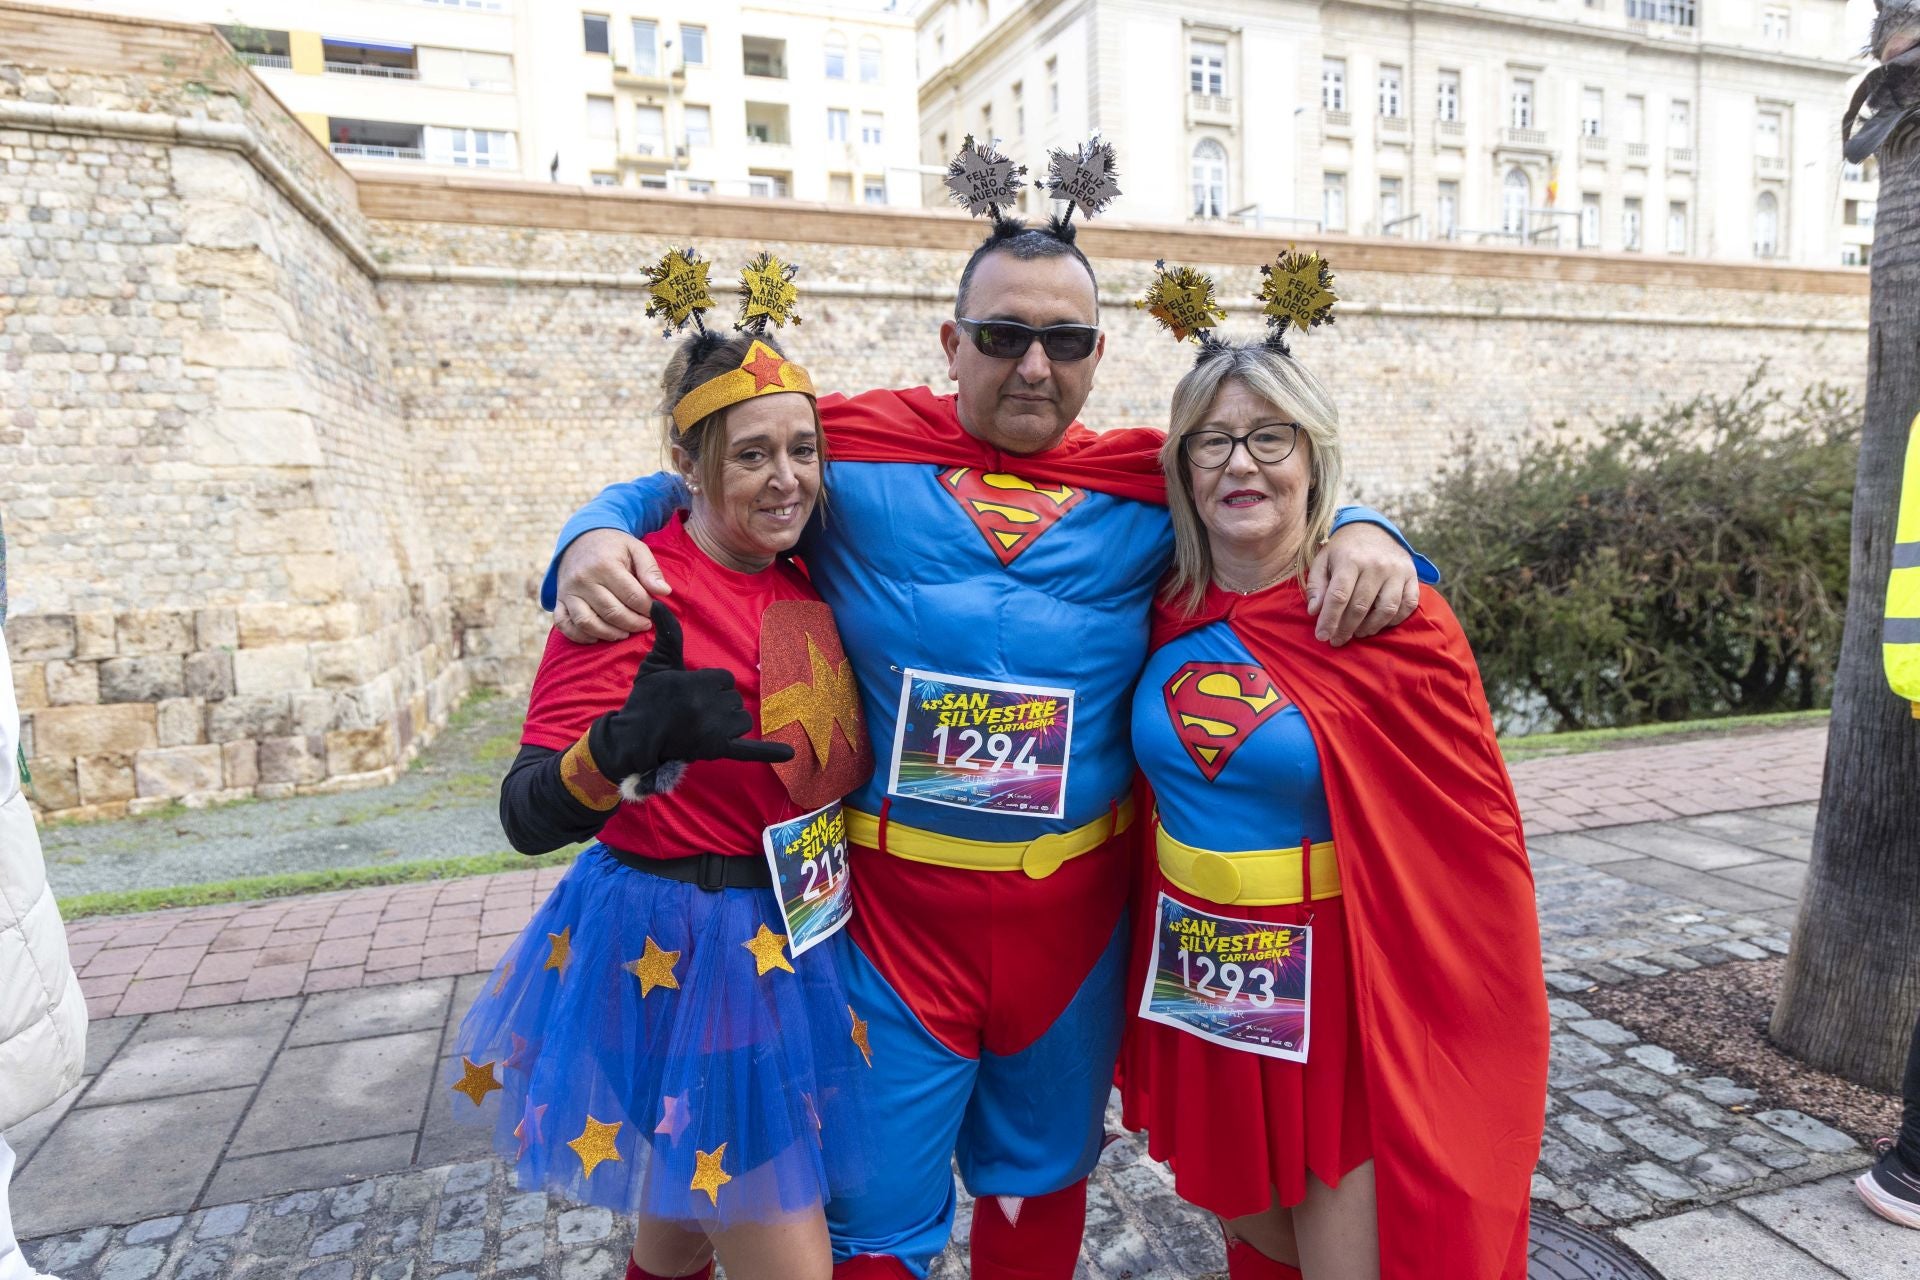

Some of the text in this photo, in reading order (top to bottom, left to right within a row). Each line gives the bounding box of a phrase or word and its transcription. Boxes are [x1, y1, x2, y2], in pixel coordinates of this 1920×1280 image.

[966, 167, 996, 183] FELIZ
[973, 177, 997, 192] AÑO
[1075, 167, 1105, 190] FELIZ
[969, 186, 1007, 204] NUEVO
[1061, 181, 1095, 207] NUEVO
[1072, 177, 1095, 196] AÑO
[668, 270, 697, 289] FELIZ
[759, 276, 785, 292] FELIZ
[1288, 278, 1320, 300] FELIZ
[675, 282, 698, 298] AÑO
[760, 287, 781, 301] AÑO
[1284, 290, 1310, 307] AÑO
[672, 291, 706, 311] NUEVO
[753, 296, 784, 314] NUEVO
[1163, 293, 1194, 313] FELIZ
[1273, 296, 1311, 320] NUEVO
[1171, 311, 1206, 330] NUEVO
[940, 692, 991, 710] SAN
[936, 700, 1058, 728] SILVESTRE
[988, 718, 1055, 734] CARTAGENA
[932, 726, 1039, 776] 1294
[801, 812, 828, 847] SAN
[800, 836, 849, 902] 213
[1181, 917, 1217, 937] SAN
[1178, 930, 1291, 953] SILVESTRE
[1219, 949, 1291, 963] CARTAGENA
[1177, 949, 1275, 1008] 1293
